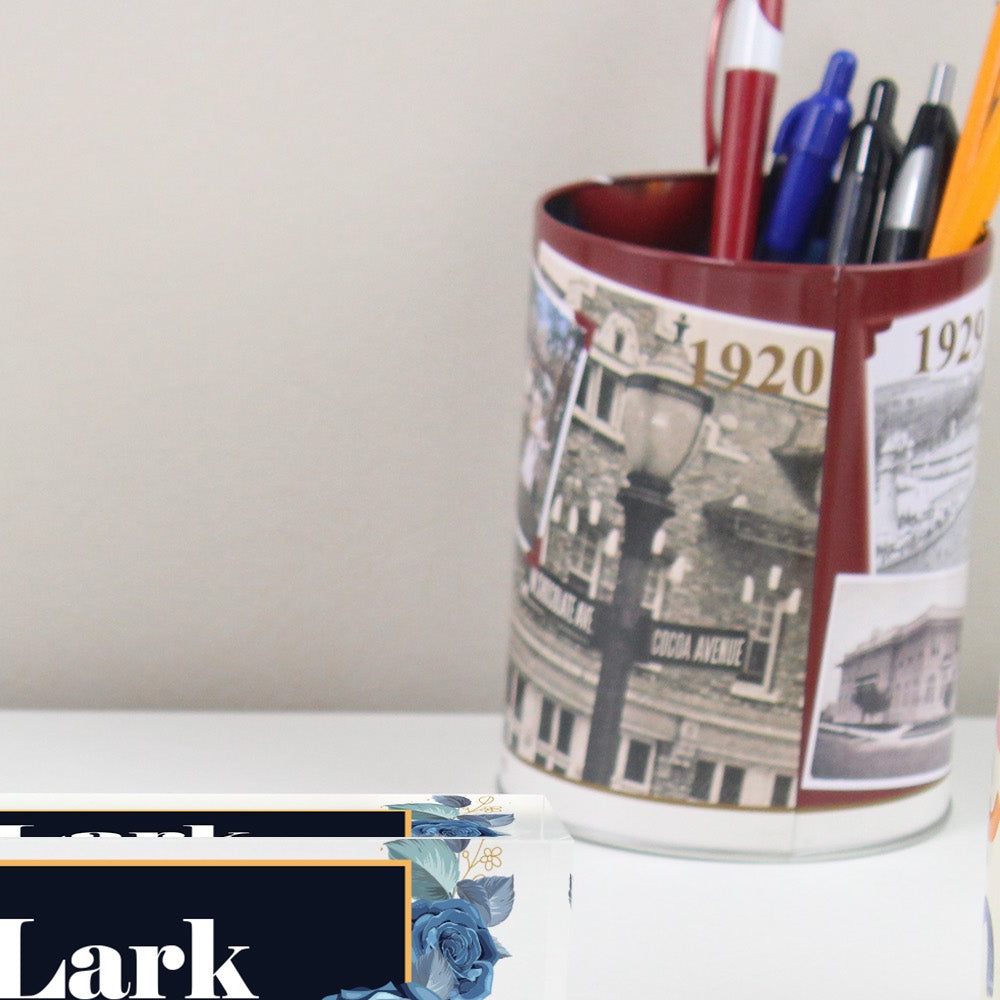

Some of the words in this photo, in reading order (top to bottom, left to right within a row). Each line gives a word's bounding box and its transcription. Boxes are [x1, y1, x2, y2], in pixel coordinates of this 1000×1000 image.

[690, 339, 824, 396] 1920
[650, 628, 692, 661] COCOA
[692, 634, 746, 668] AVENUE
